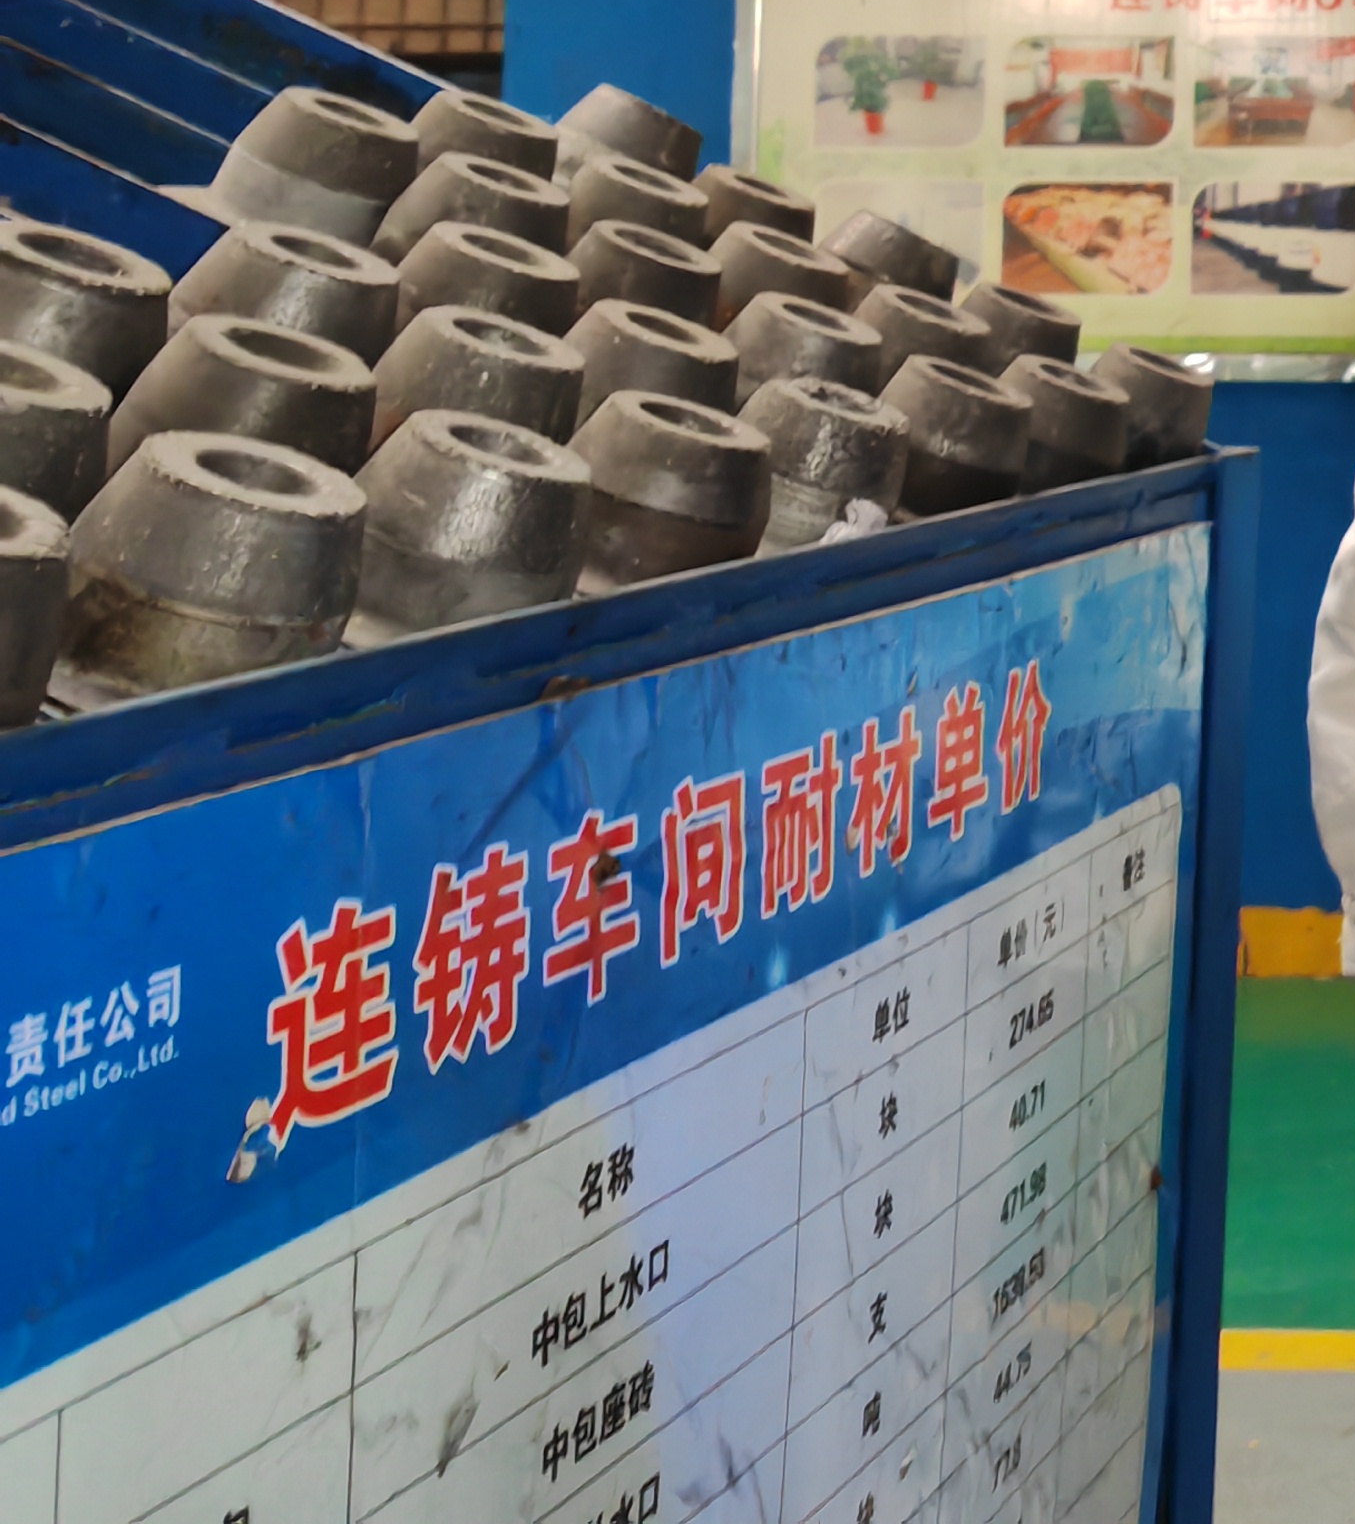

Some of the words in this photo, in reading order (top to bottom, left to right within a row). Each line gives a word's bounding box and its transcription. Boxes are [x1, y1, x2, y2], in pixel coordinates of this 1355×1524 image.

[267, 658, 1052, 1155] 连铸车间耐材单价
[23, 1067, 87, 1117] Steel
[578, 1143, 636, 1218] 名称
[872, 986, 911, 1044] 单位
[531, 1239, 669, 1366] 中包上水口
[541, 1359, 655, 1483] 中包座砖
